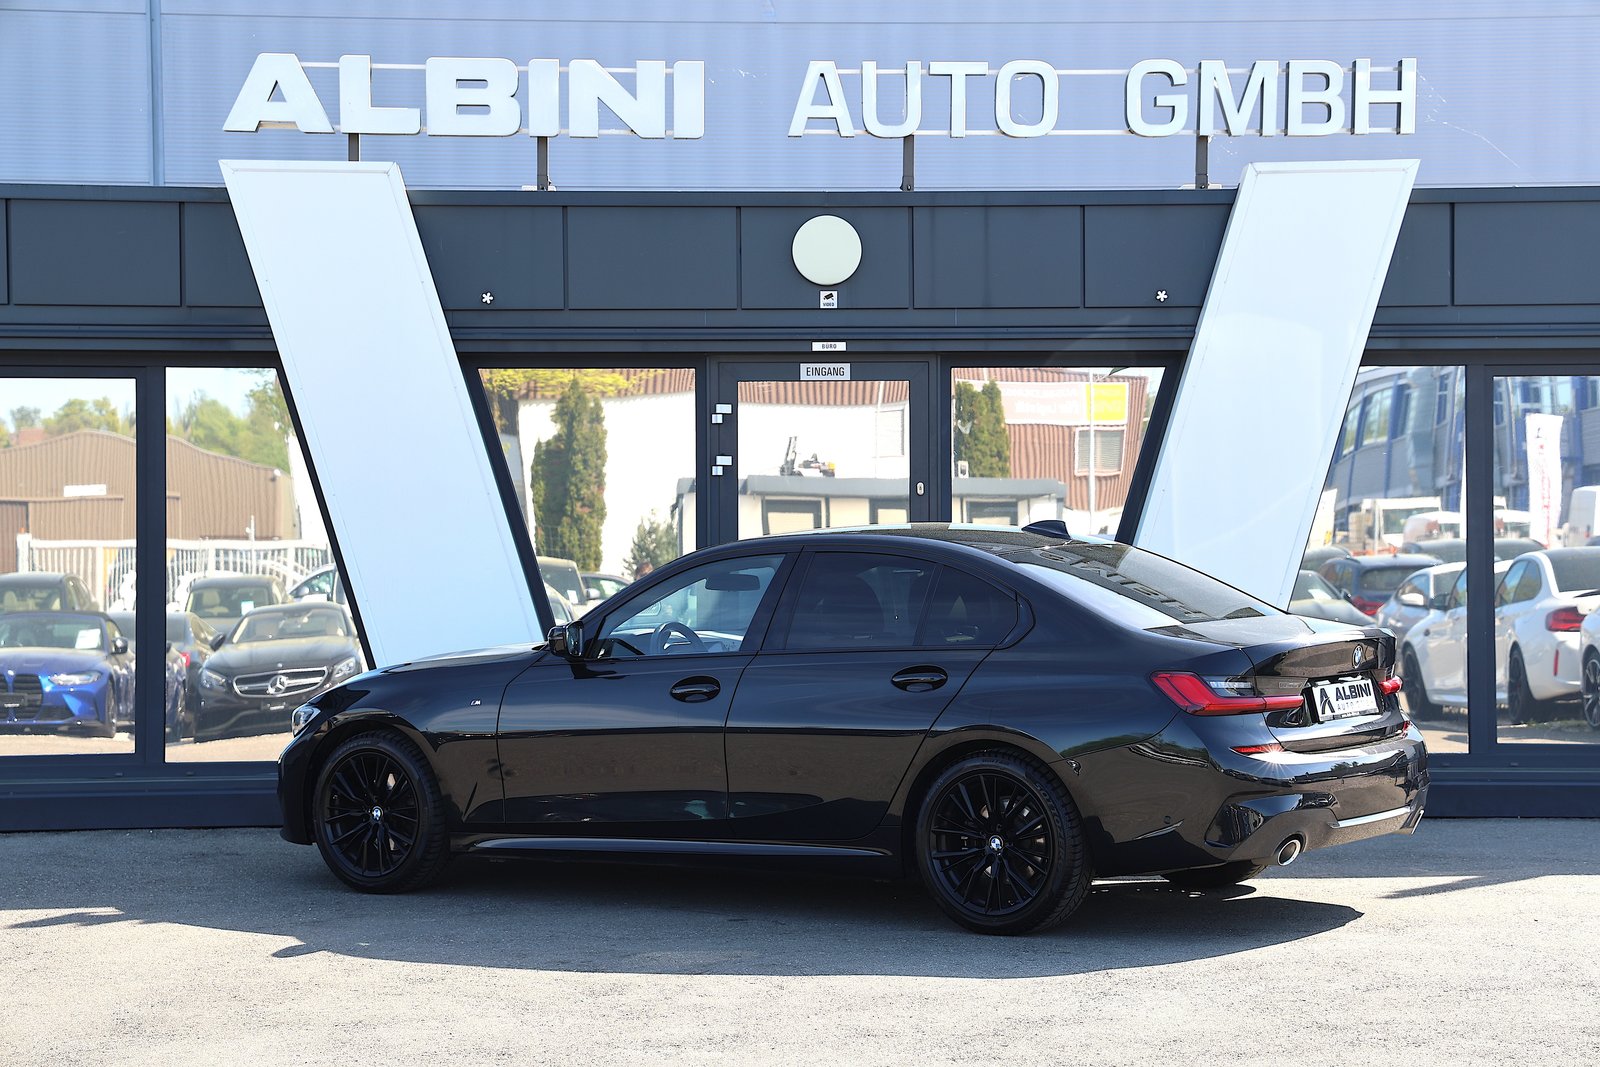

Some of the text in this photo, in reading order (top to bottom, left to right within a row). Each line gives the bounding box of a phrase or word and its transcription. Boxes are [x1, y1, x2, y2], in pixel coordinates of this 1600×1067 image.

[223, 52, 1418, 139] ALBINI AUTO GMBH
[806, 366, 845, 377] EINGANG
[1336, 683, 1371, 701] ALBINI
